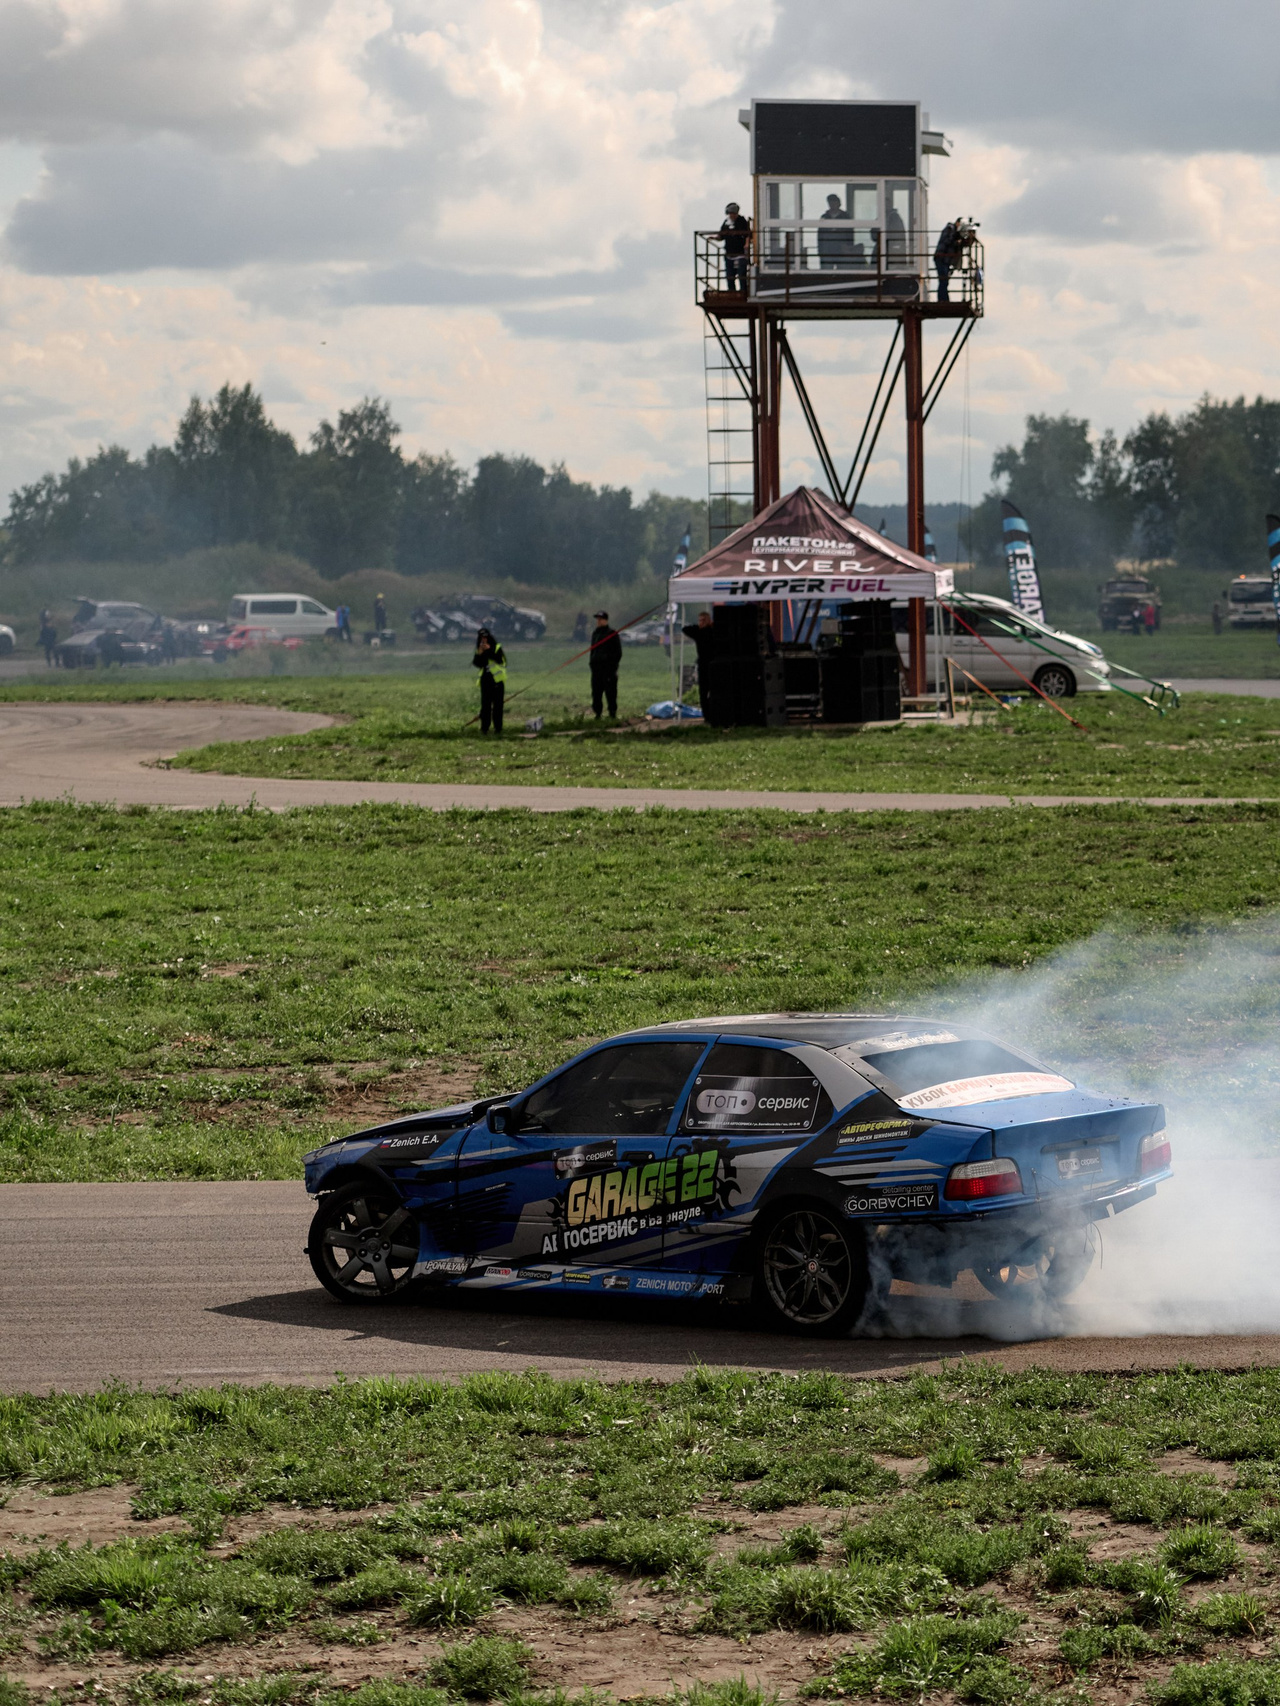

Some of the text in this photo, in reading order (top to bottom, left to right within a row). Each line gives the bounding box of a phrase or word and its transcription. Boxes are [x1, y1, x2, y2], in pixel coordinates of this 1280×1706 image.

[744, 559, 875, 573] RIVER
[728, 578, 892, 595] HYPER FUEL
[706, 1094, 810, 1112] ТОП сервис
[906, 1087, 949, 1109] КУБОК
[390, 1134, 440, 1148] Zenich E.A.
[586, 1149, 614, 1162] сервис
[567, 1150, 719, 1226] GARAGE 22
[882, 1185, 934, 1195] detailing center
[636, 1277, 665, 1291] ZENICH
[667, 1280, 724, 1295] MOTOPORT
